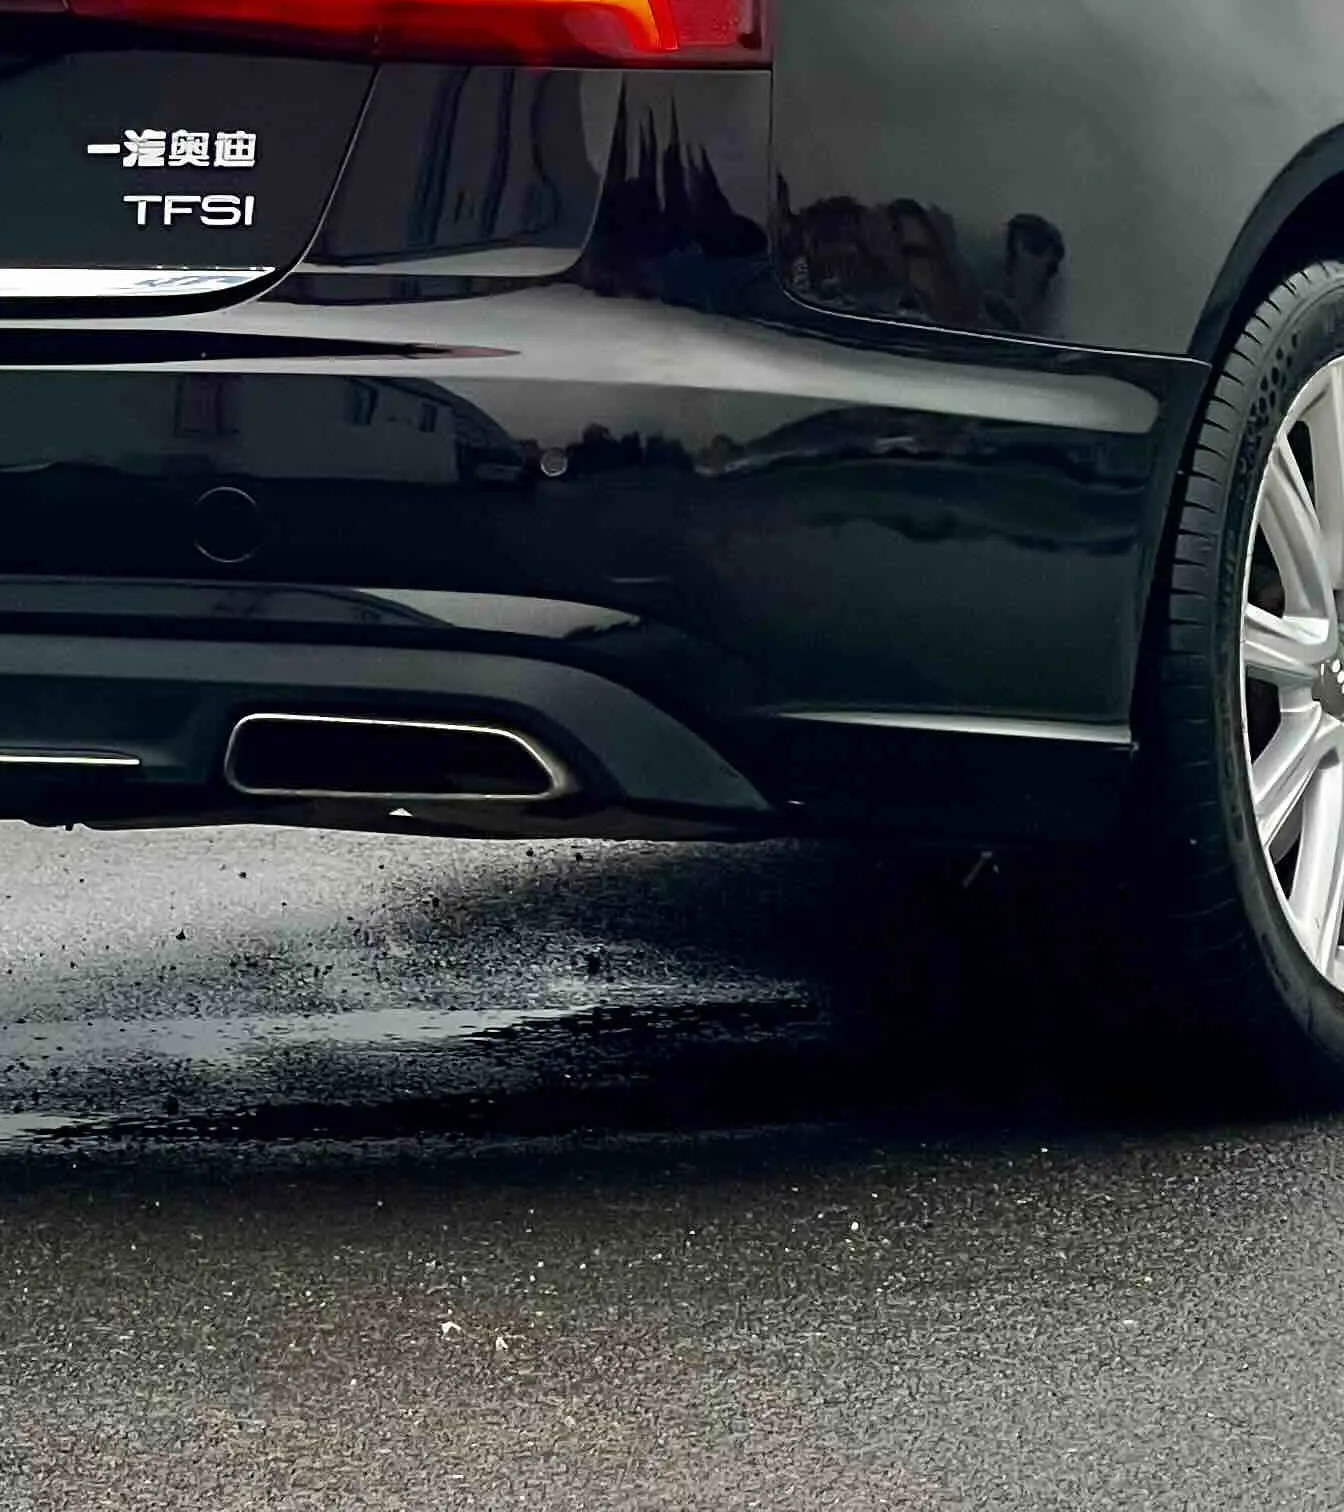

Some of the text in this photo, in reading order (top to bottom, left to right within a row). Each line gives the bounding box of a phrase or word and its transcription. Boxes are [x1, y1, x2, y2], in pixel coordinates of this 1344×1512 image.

[87, 128, 257, 168] 一汽奥迪
[123, 194, 255, 226] TFSI
